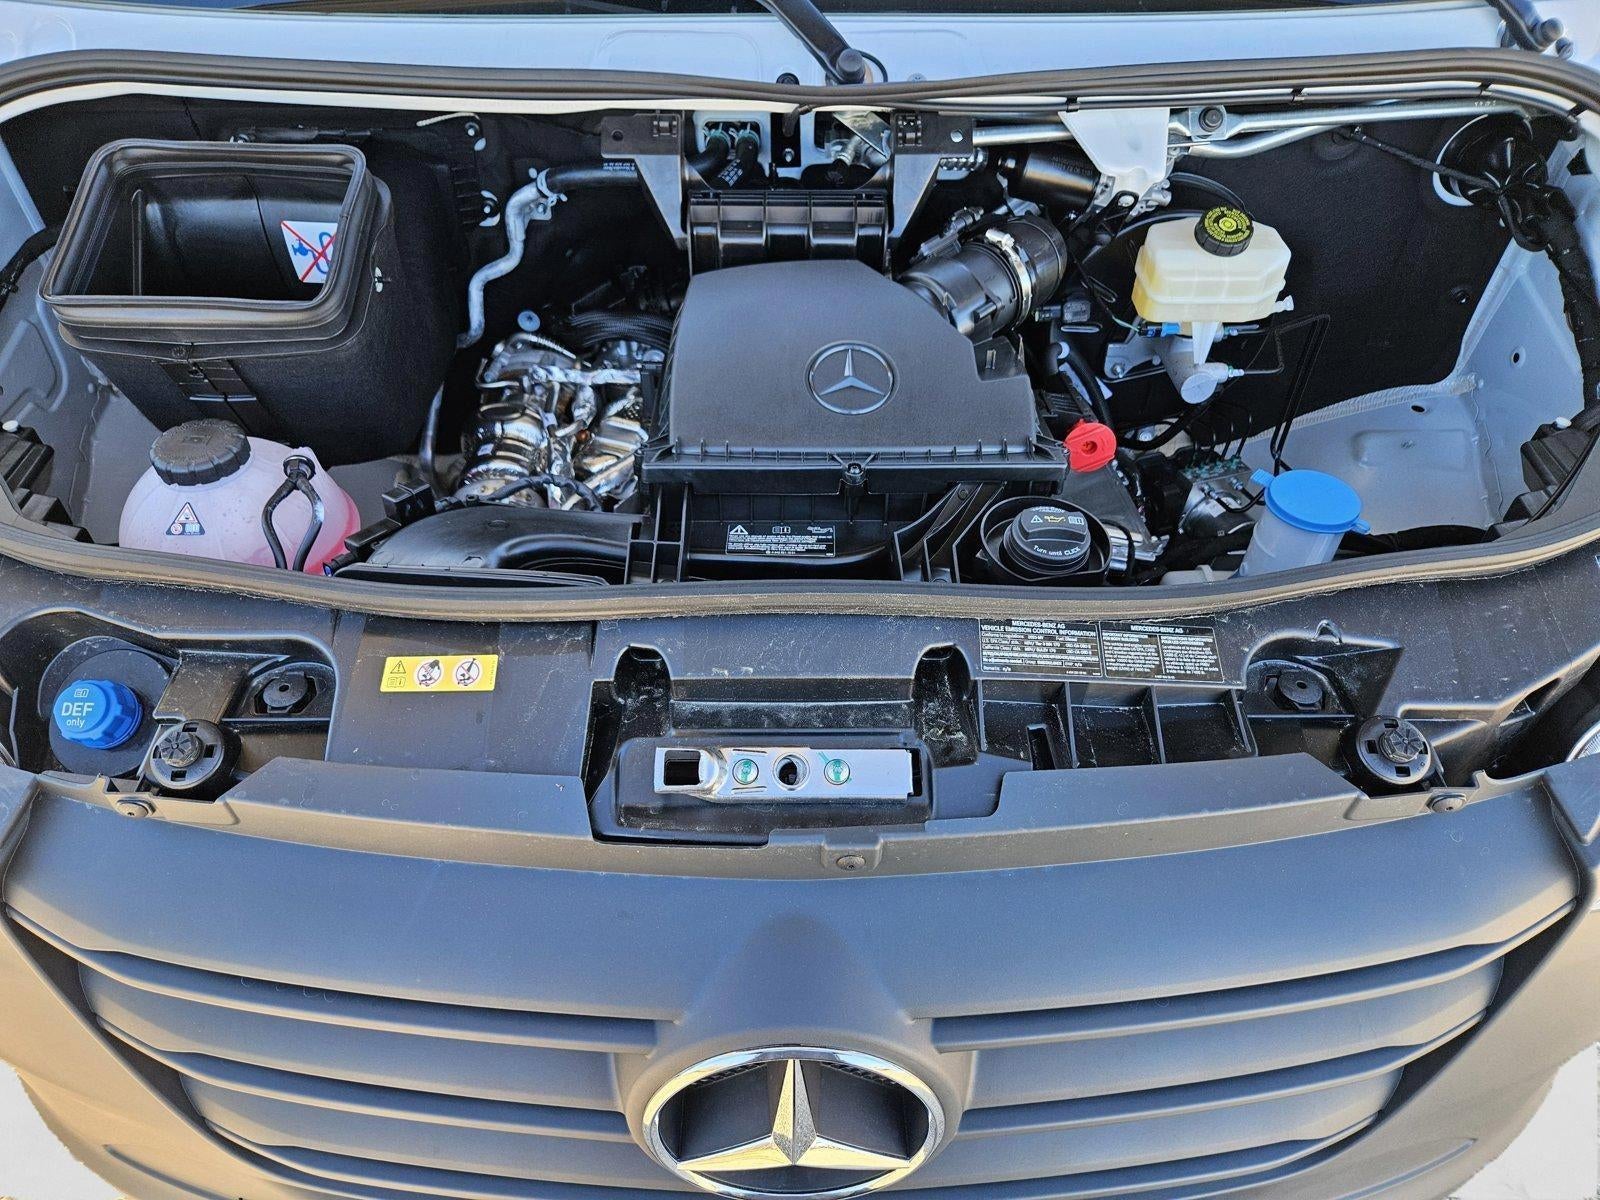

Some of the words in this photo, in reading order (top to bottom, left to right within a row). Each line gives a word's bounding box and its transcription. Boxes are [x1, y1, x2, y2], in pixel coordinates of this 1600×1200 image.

[1034, 545, 1047, 554] Turn
[1064, 546, 1081, 555] CLICK
[1012, 620, 1056, 629] MERCEDES-BENZ
[1131, 625, 1174, 633] MERCEDES-BENZ
[62, 702, 94, 716] DEF
[66, 718, 85, 728] only
